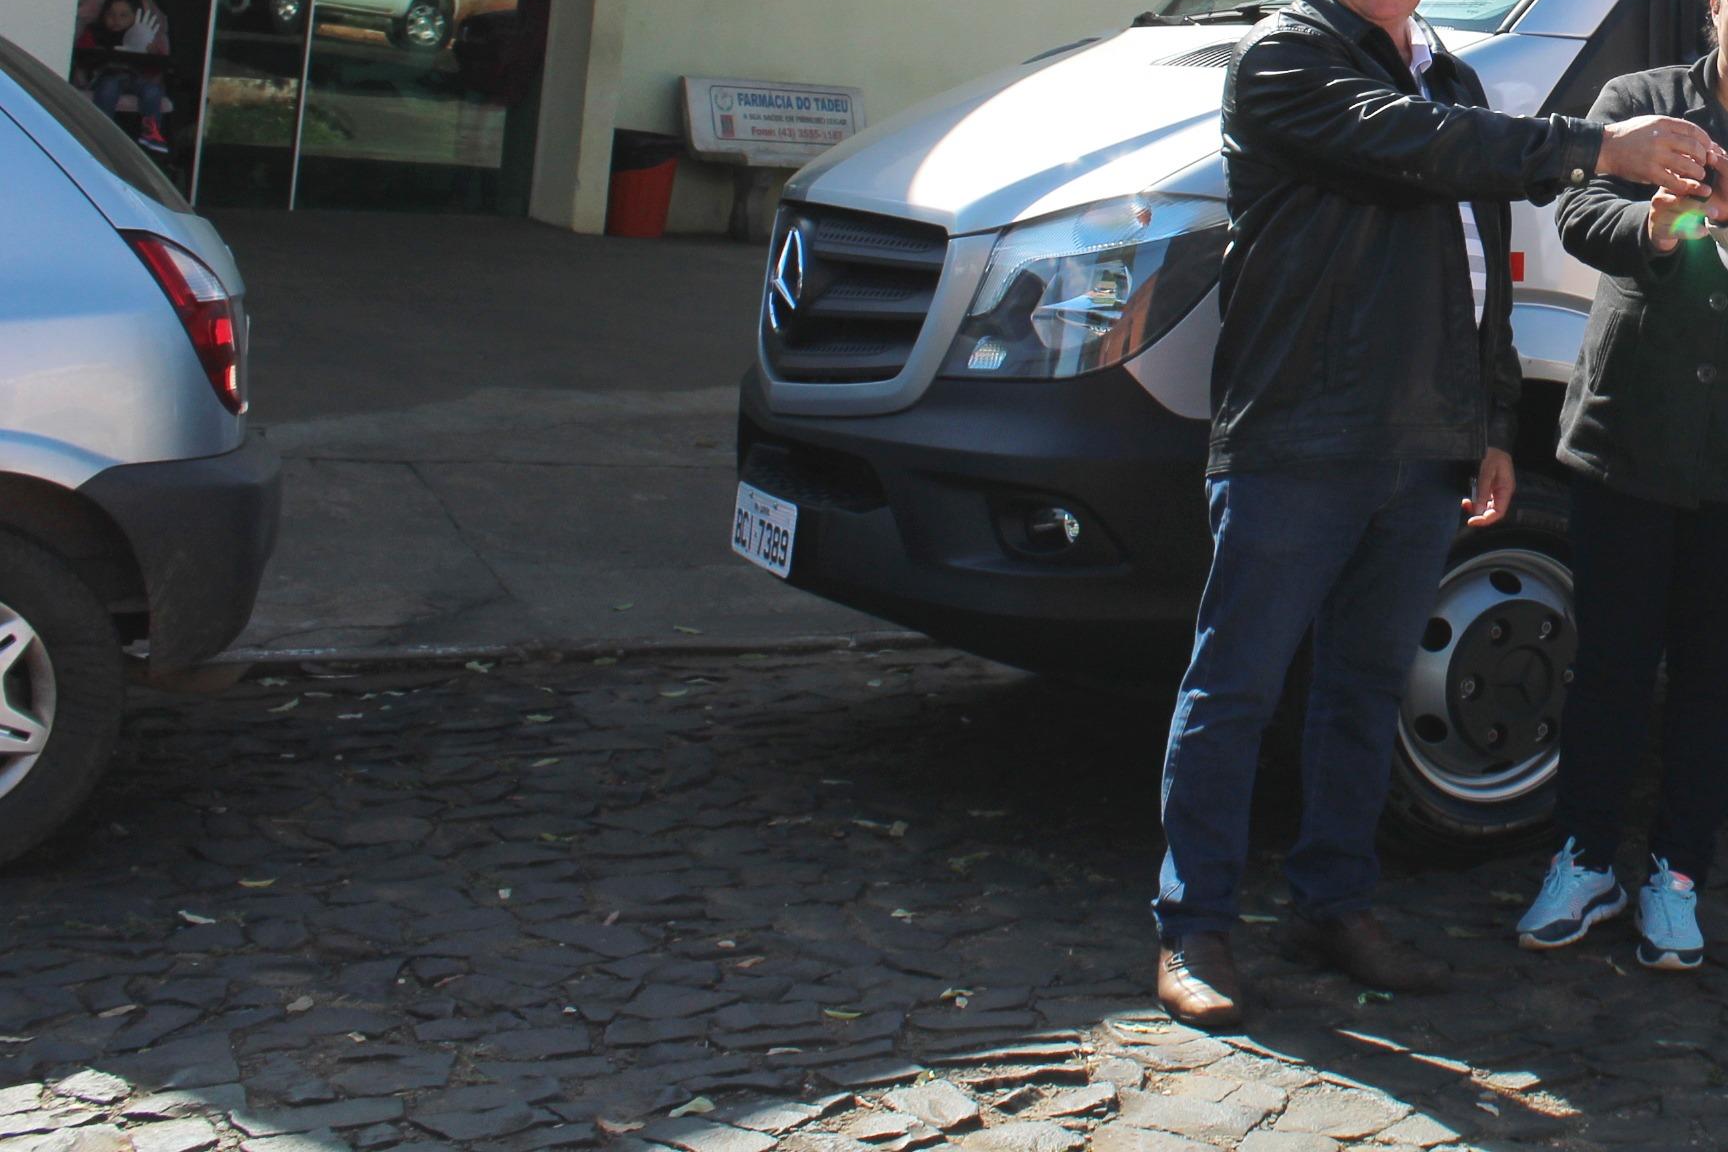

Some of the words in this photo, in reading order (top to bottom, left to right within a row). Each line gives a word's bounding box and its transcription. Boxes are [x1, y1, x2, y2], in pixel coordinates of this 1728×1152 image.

[737, 90, 793, 110] FARMÁCIA
[796, 96, 811, 110] DO
[814, 97, 849, 113] TADEU
